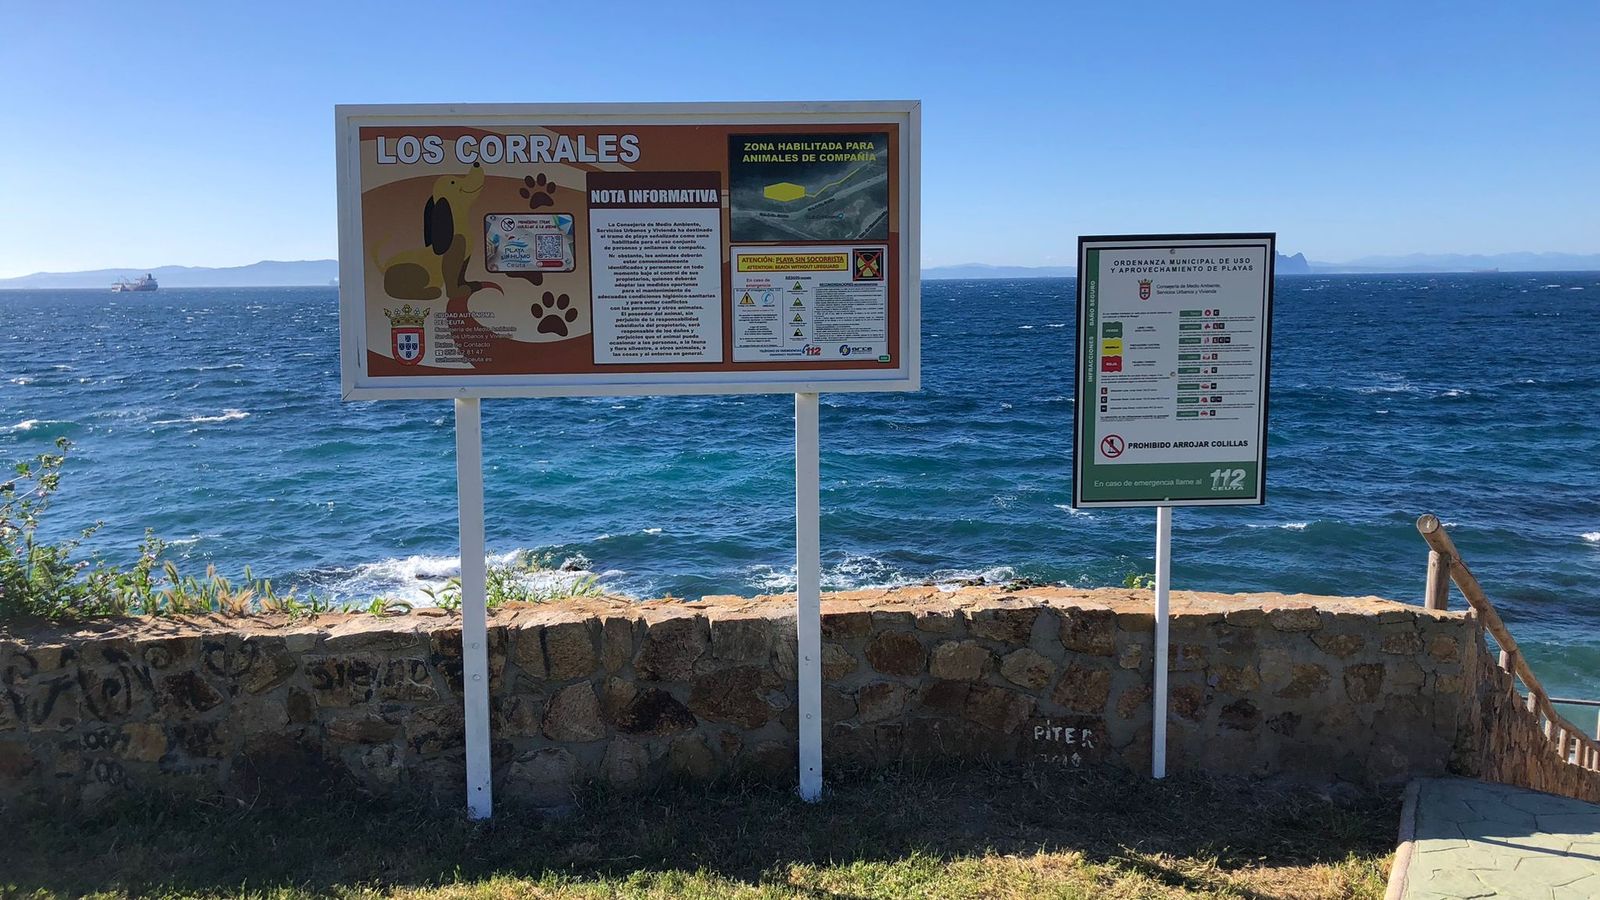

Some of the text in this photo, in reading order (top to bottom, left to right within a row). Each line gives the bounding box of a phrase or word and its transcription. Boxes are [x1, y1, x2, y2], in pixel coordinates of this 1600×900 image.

[376, 134, 641, 165] LOS CORRALES
[744, 142, 874, 151] ZONA HABILITADA PARA
[742, 154, 798, 162] ANIMALES
[802, 154, 816, 162] DE
[591, 190, 718, 203] NOTA INFORMATIVA
[806, 347, 821, 355] 112
[1210, 468, 1247, 487] 112
